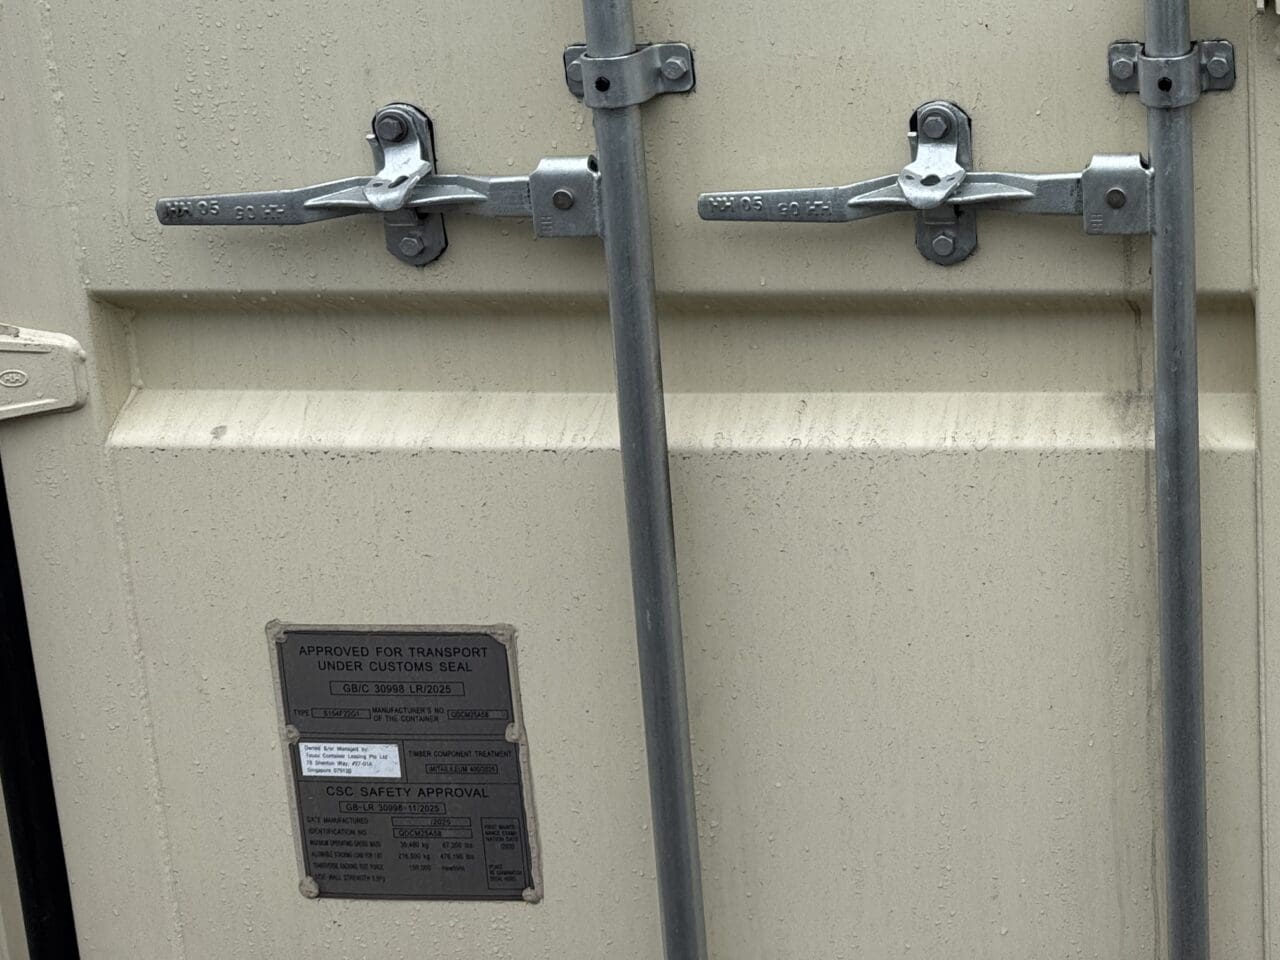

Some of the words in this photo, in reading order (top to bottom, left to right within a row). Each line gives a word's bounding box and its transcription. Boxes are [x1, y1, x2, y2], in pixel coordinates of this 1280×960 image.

[299, 645, 370, 657] APPROVED
[376, 646, 403, 658] FOR
[408, 646, 488, 658] TRANSPORT
[318, 660, 364, 672] UNDER
[369, 661, 433, 673] CUSTOMS
[439, 661, 473, 673] SEAL
[342, 683, 370, 693] GB/C
[409, 684, 452, 694] LR/2025
[408, 750, 431, 758] TIMBER
[432, 750, 473, 759] COMPONENT
[474, 750, 512, 759] TREATMENT
[326, 785, 354, 797] CSC
[360, 786, 412, 798] SAFETY
[417, 787, 489, 799] APPROVAL
